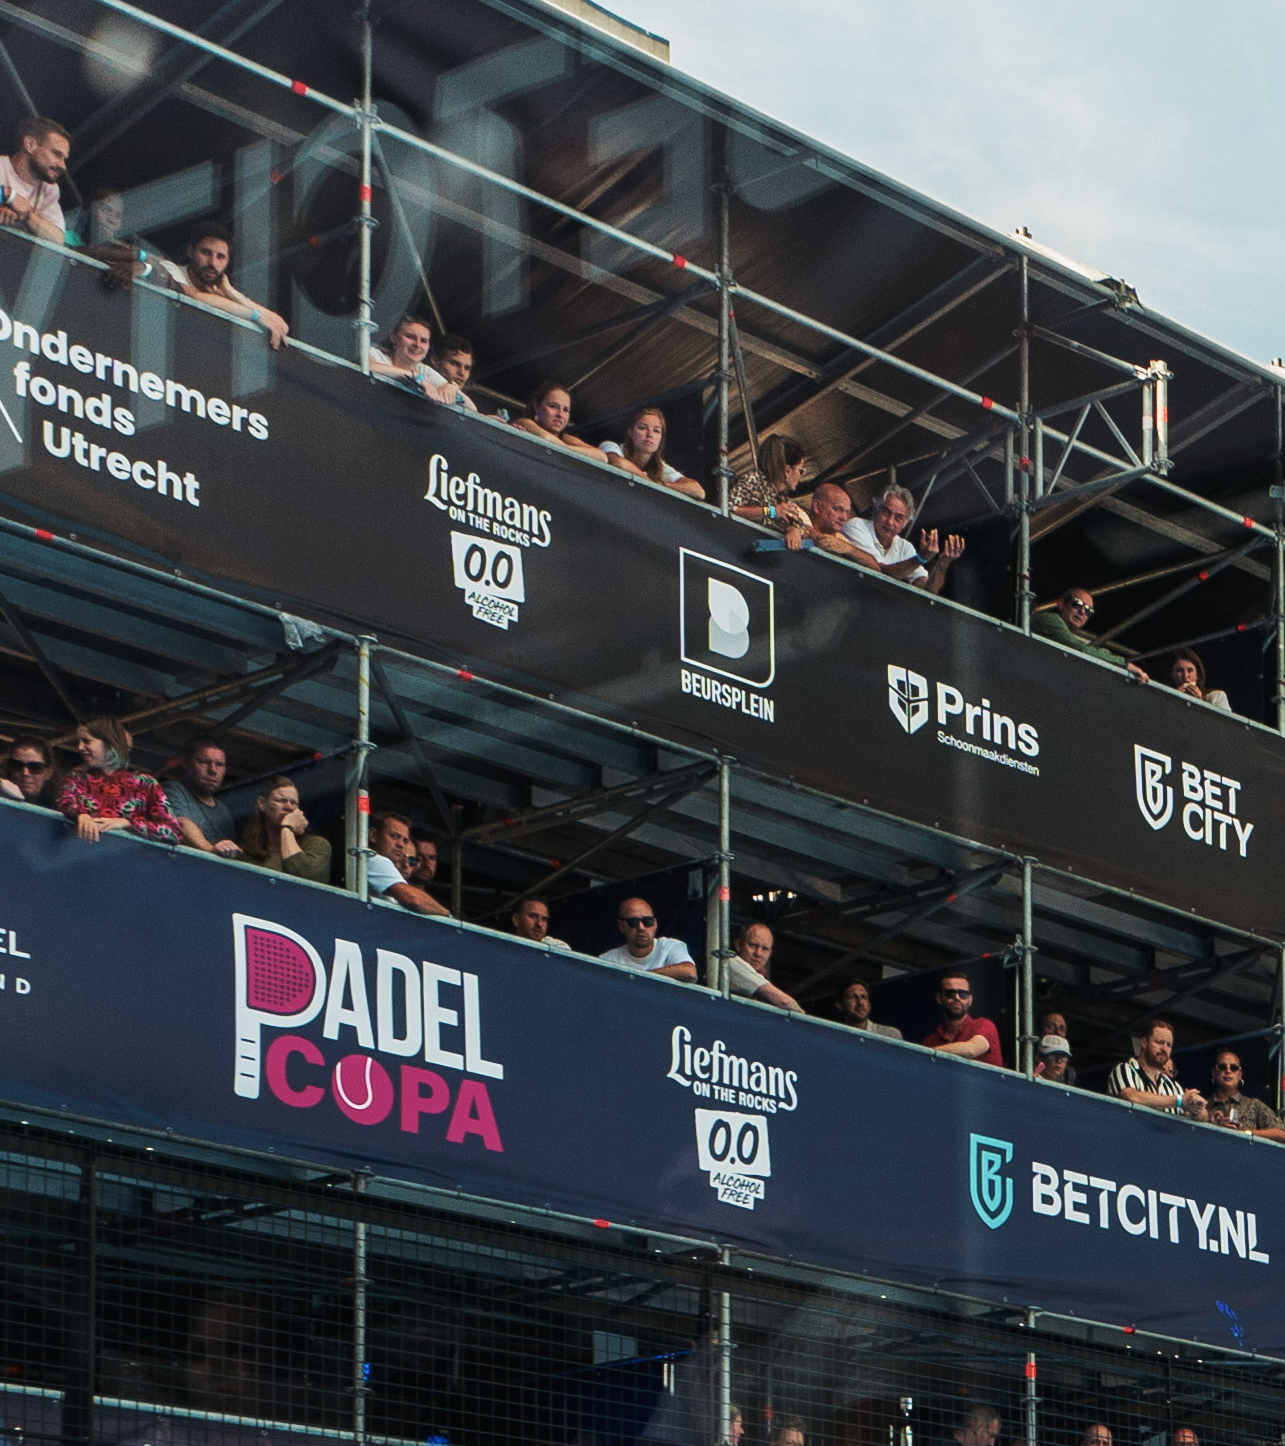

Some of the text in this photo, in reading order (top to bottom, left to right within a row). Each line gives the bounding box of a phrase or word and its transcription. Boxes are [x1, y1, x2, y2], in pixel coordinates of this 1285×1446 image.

[14, 361, 136, 436] fonds
[42, 420, 200, 507] Utrecht
[424, 454, 552, 548] Liefmans
[450, 505, 531, 548] ON THE ROCKS
[464, 543, 513, 590] 0.0
[468, 591, 516, 617] ALCOHOL
[476, 607, 505, 625] FREE
[681, 669, 774, 723] BEURSPLEIN
[936, 681, 1040, 756] Prins
[937, 730, 1040, 777] Schoonmaakdiensten
[1182, 761, 1241, 815] BET
[1182, 802, 1254, 858] CITY
[232, 913, 504, 1098] PADEL
[266, 1034, 504, 1152] COPA
[666, 1025, 798, 1112] Liefmans
[693, 1080, 777, 1114] ON THE ROCKS
[708, 1118, 759, 1165] 0.0
[713, 1172, 761, 1195] ALCOHOL
[720, 1188, 751, 1205] FREE
[1031, 1161, 1270, 1265] BETCITY.NL
